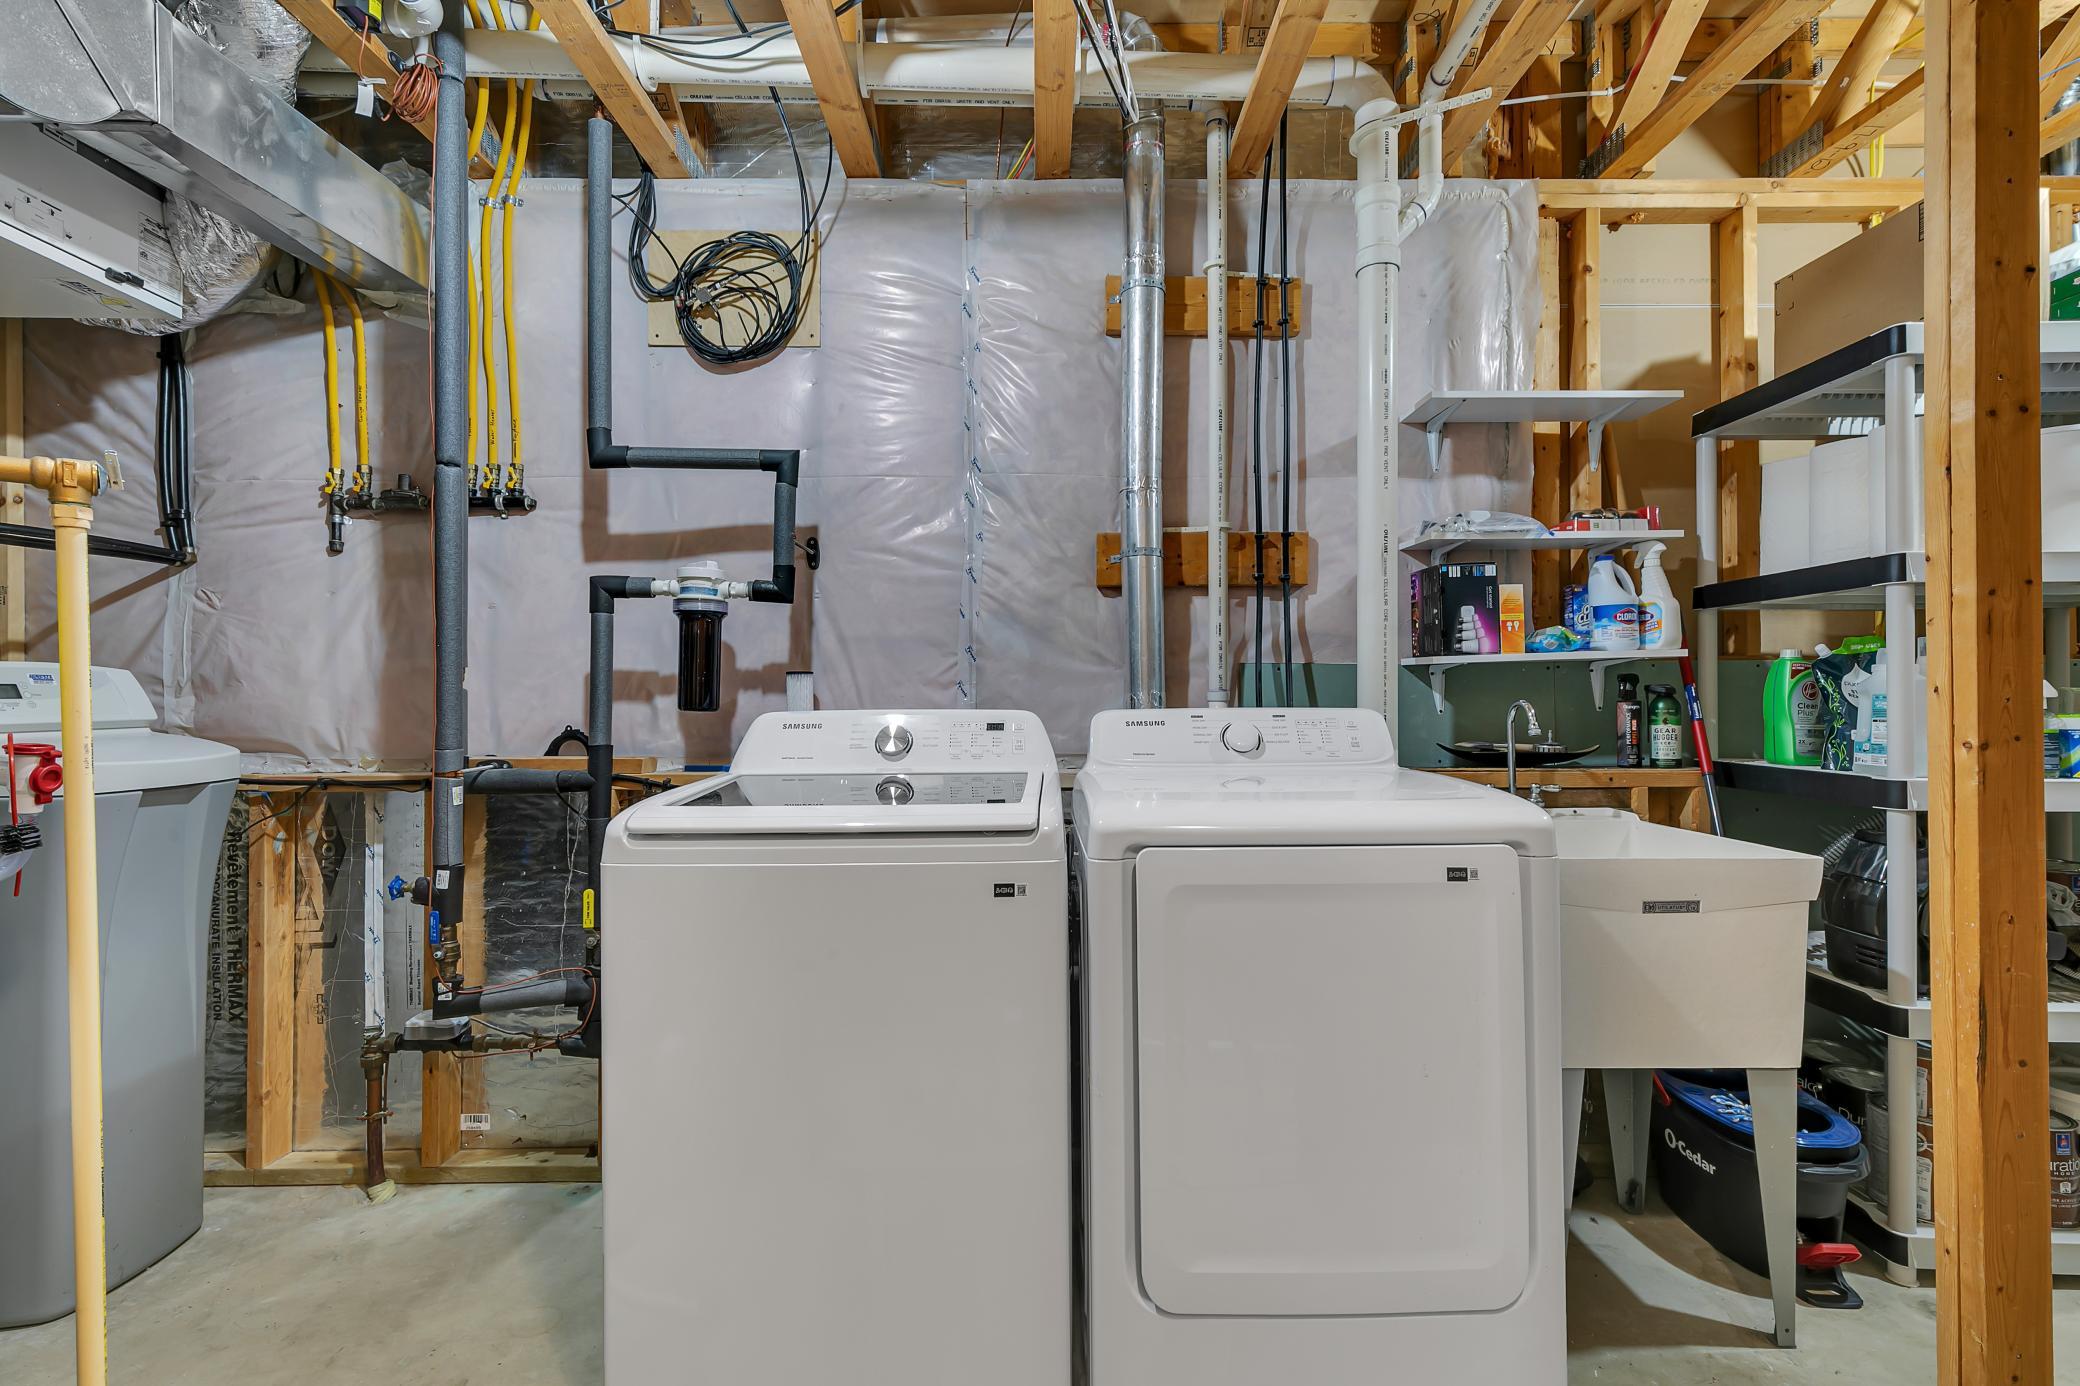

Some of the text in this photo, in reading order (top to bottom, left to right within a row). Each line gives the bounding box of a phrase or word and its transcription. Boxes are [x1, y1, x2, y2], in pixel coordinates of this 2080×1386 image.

[782, 722, 823, 730] SAMSUNG
[1798, 702, 1819, 710] Clean
[322, 825, 338, 877] DOW
[226, 831, 244, 1021] Revêtement THERMAX
[212, 953, 223, 1020] INSULATION
